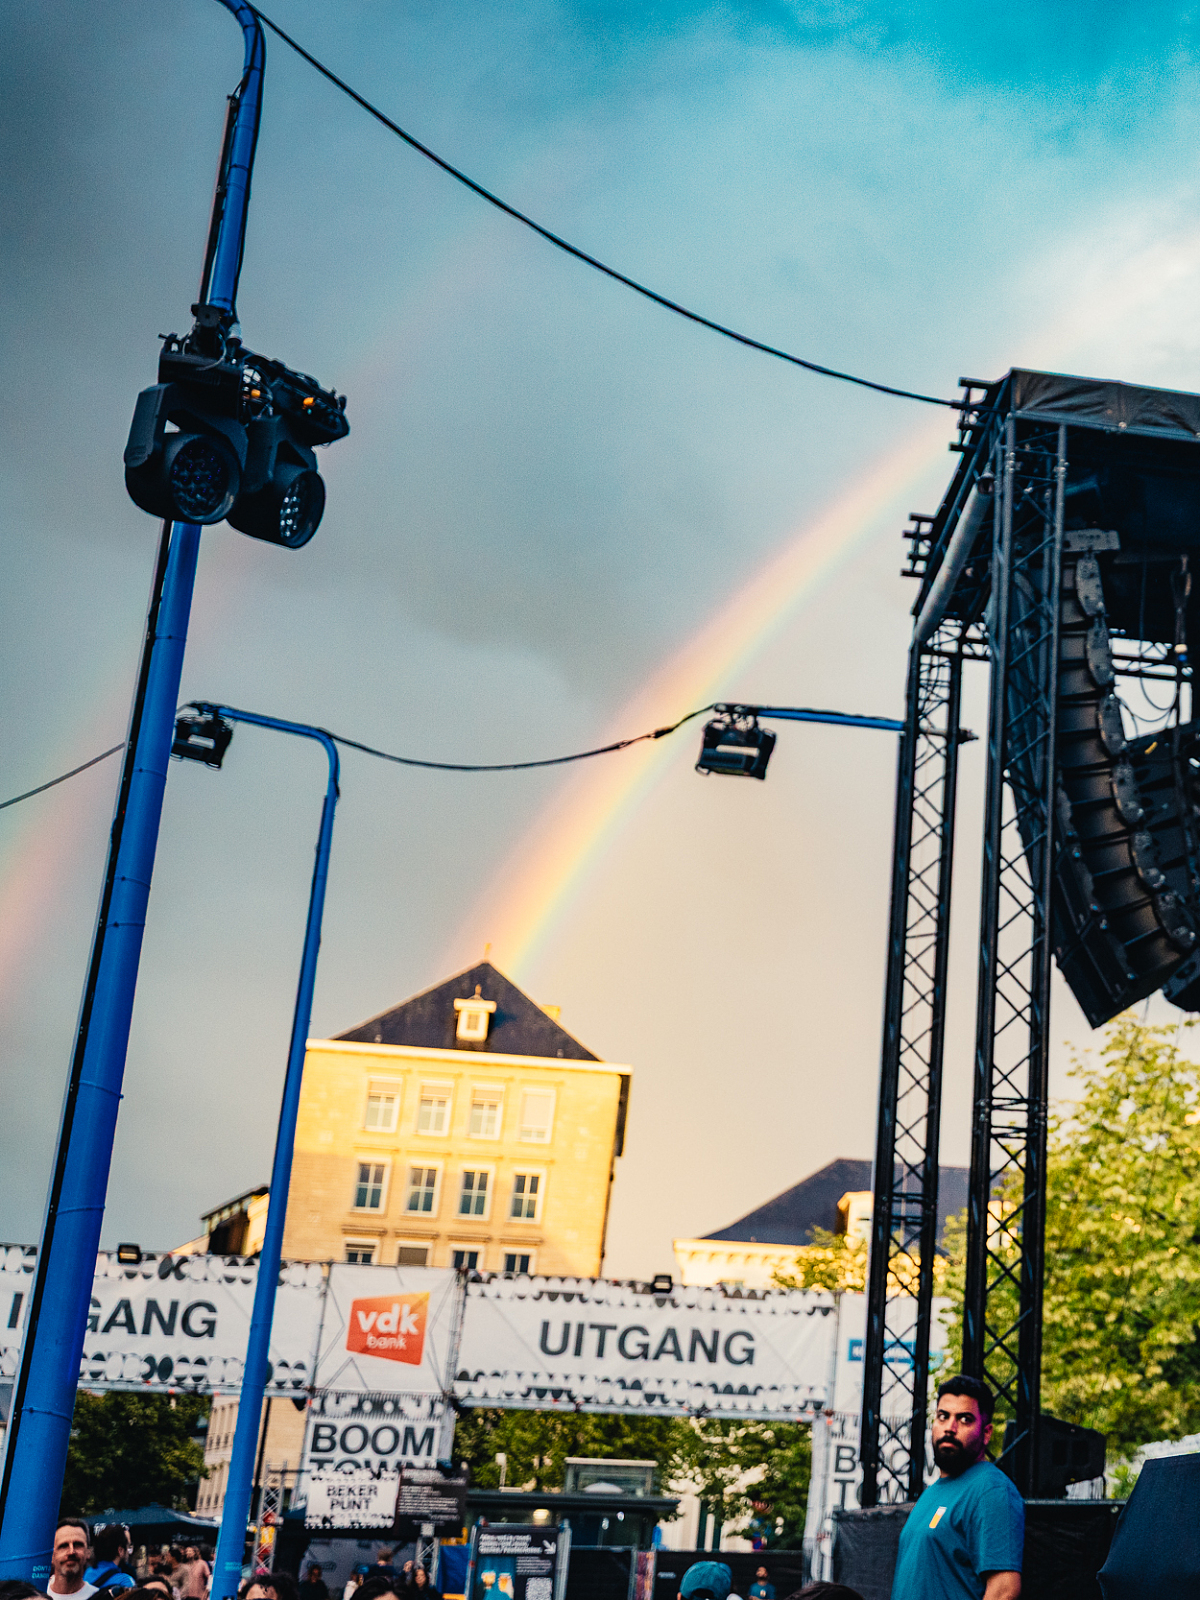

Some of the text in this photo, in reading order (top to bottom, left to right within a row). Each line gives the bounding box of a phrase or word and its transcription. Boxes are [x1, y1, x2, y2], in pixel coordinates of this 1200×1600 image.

[357, 1303, 420, 1335] vdk
[366, 1332, 407, 1350] bank
[539, 1320, 755, 1365] UITGANG
[311, 1423, 435, 1457] BOOM
[326, 1484, 377, 1497] BEKER
[330, 1497, 371, 1510] PUNT
